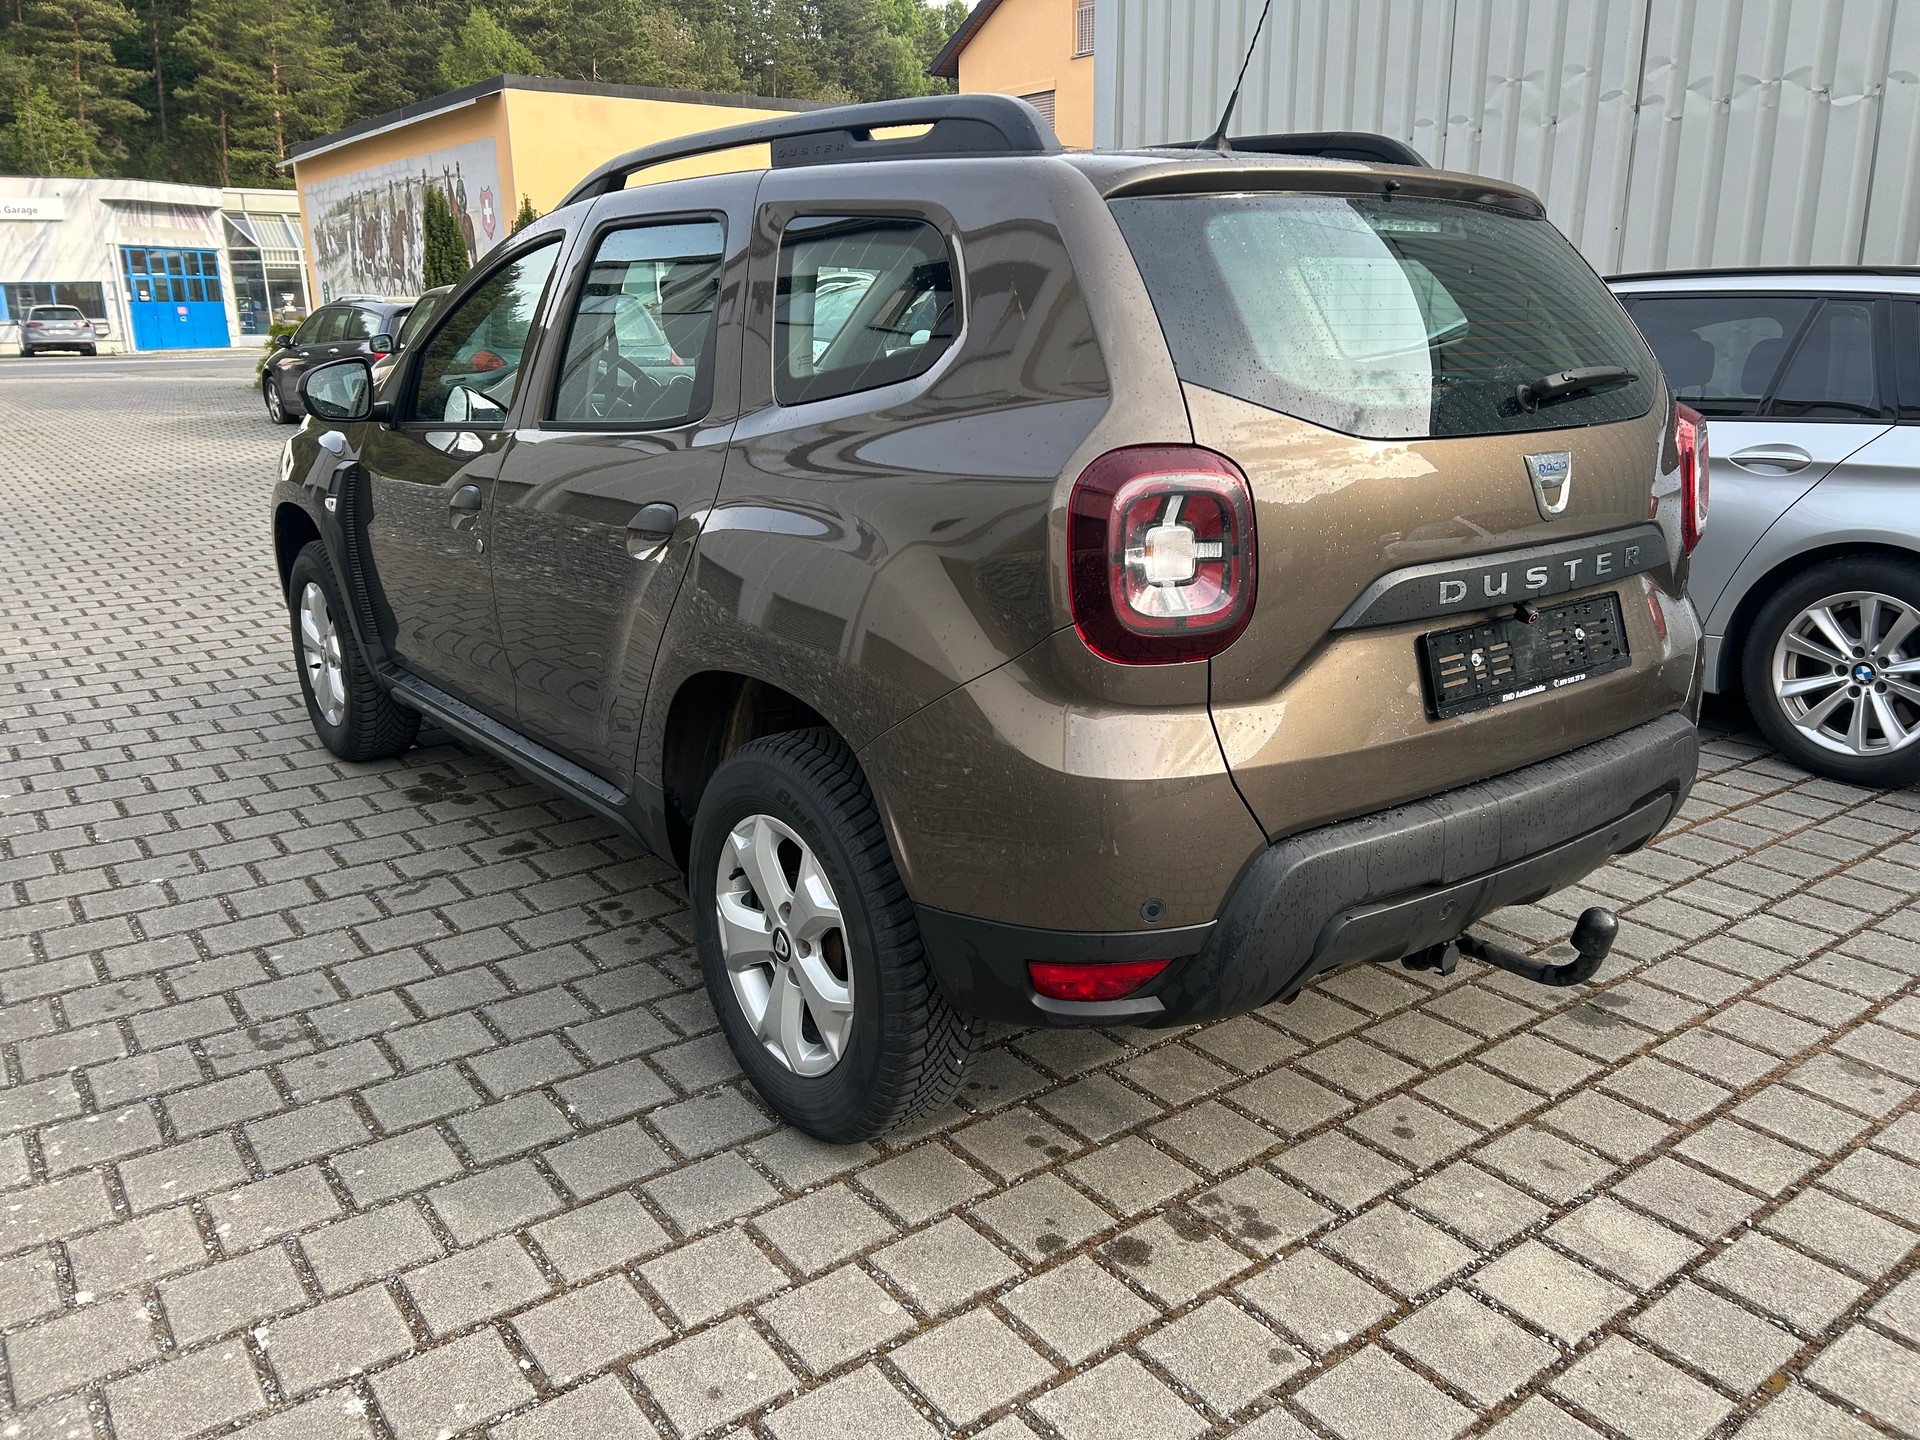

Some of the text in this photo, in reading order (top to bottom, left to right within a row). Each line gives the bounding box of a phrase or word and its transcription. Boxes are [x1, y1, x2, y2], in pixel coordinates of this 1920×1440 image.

[777, 143, 845, 158] DUSTER
[3, 205, 39, 216] Garage
[1538, 461, 1568, 474] DACIA
[1439, 545, 1640, 605] DUSTER
[1515, 684, 1547, 699] Automobile
